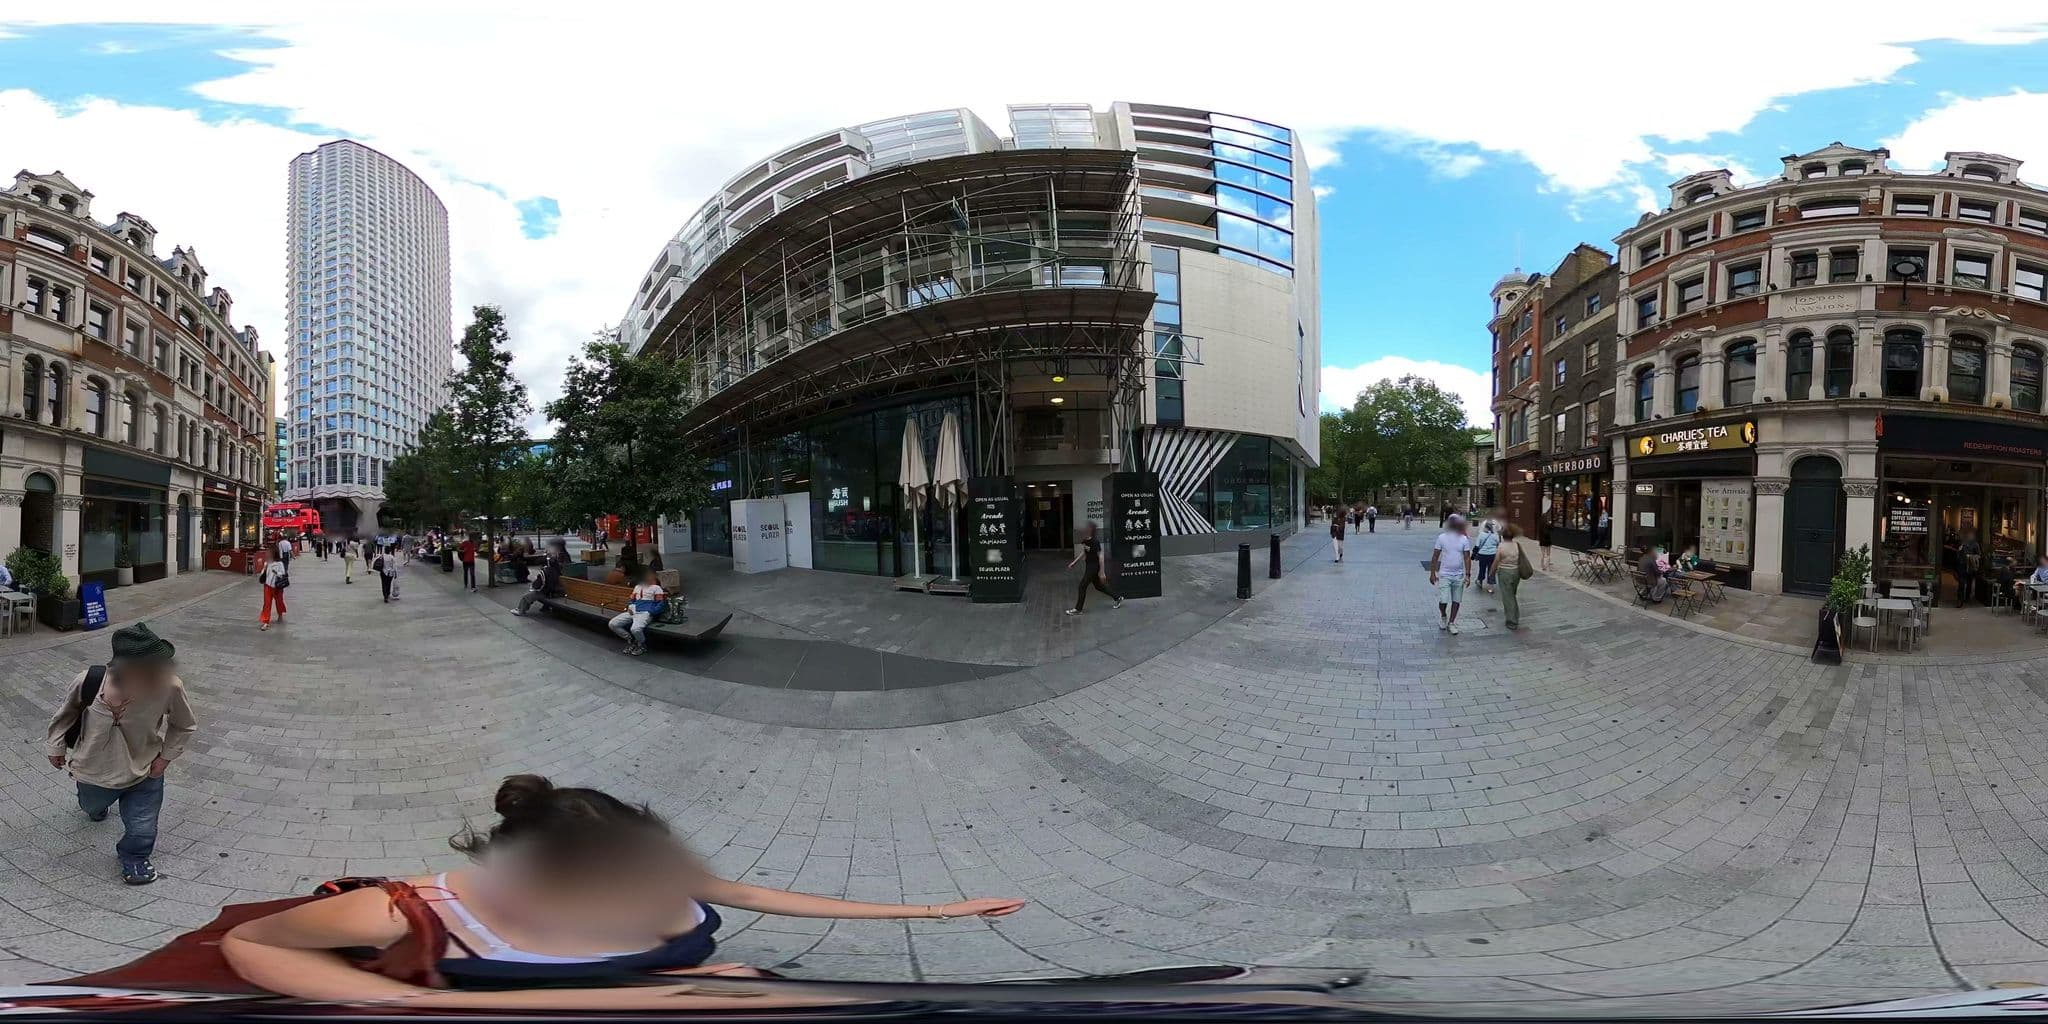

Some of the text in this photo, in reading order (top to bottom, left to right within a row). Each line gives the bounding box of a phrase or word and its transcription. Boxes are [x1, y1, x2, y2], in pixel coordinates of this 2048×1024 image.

[1795, 294, 1844, 305] LONDON
[1787, 304, 1854, 313] MANSIONS
[1661, 425, 1728, 443] CHARLIE'S TEA
[2008, 446, 2042, 456] ROASTERS
[1542, 457, 1601, 475] UNDERBOBO
[761, 531, 780, 540] PLAZA
